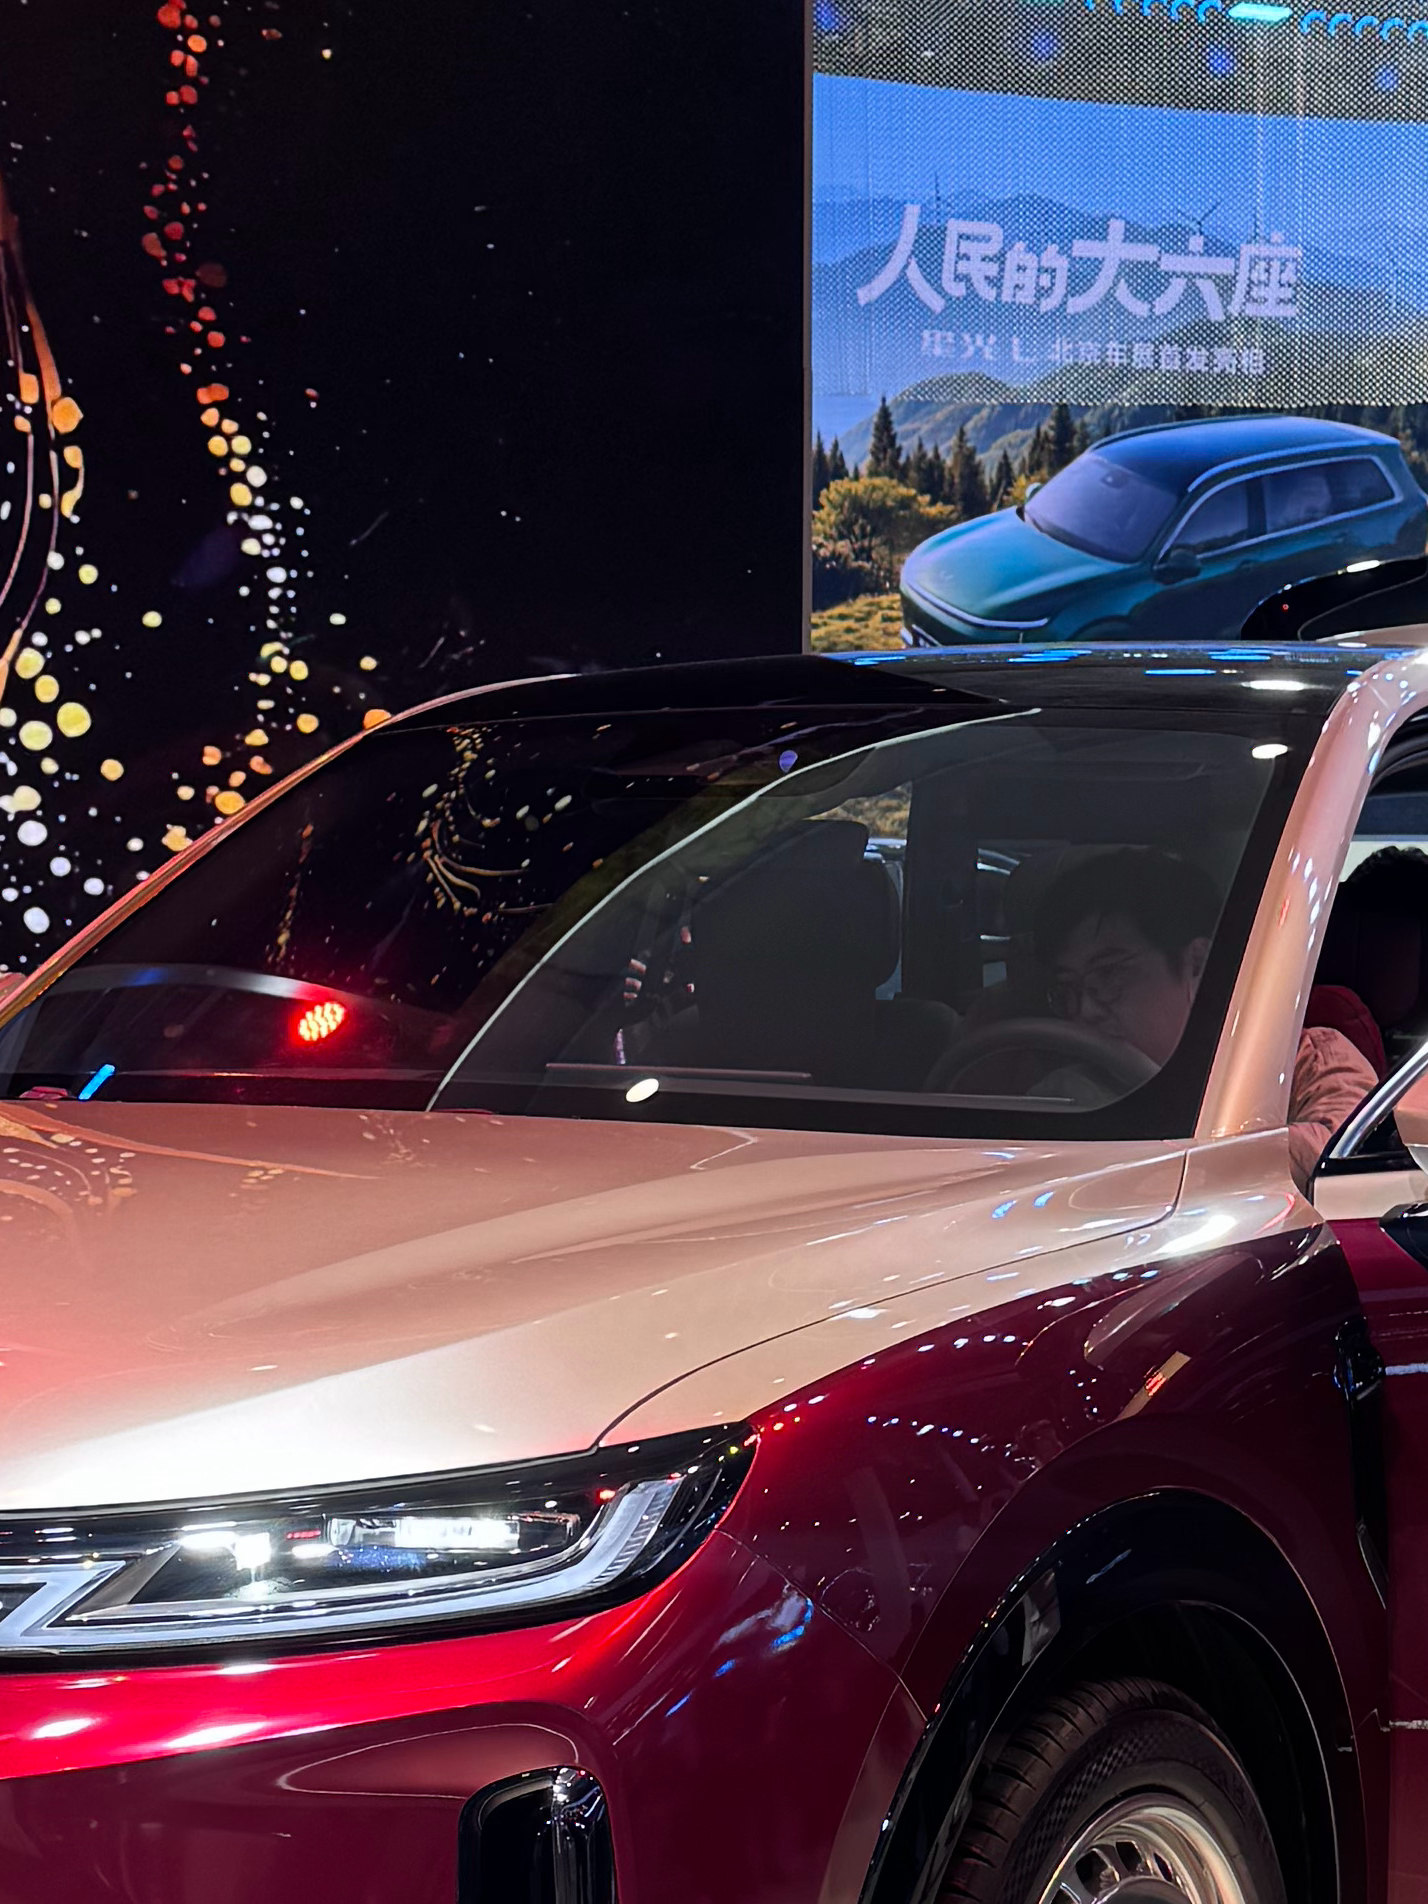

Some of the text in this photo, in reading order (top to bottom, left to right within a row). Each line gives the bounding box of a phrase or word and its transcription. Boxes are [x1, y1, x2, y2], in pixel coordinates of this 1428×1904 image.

[857, 203, 1303, 323] 人民的大六座
